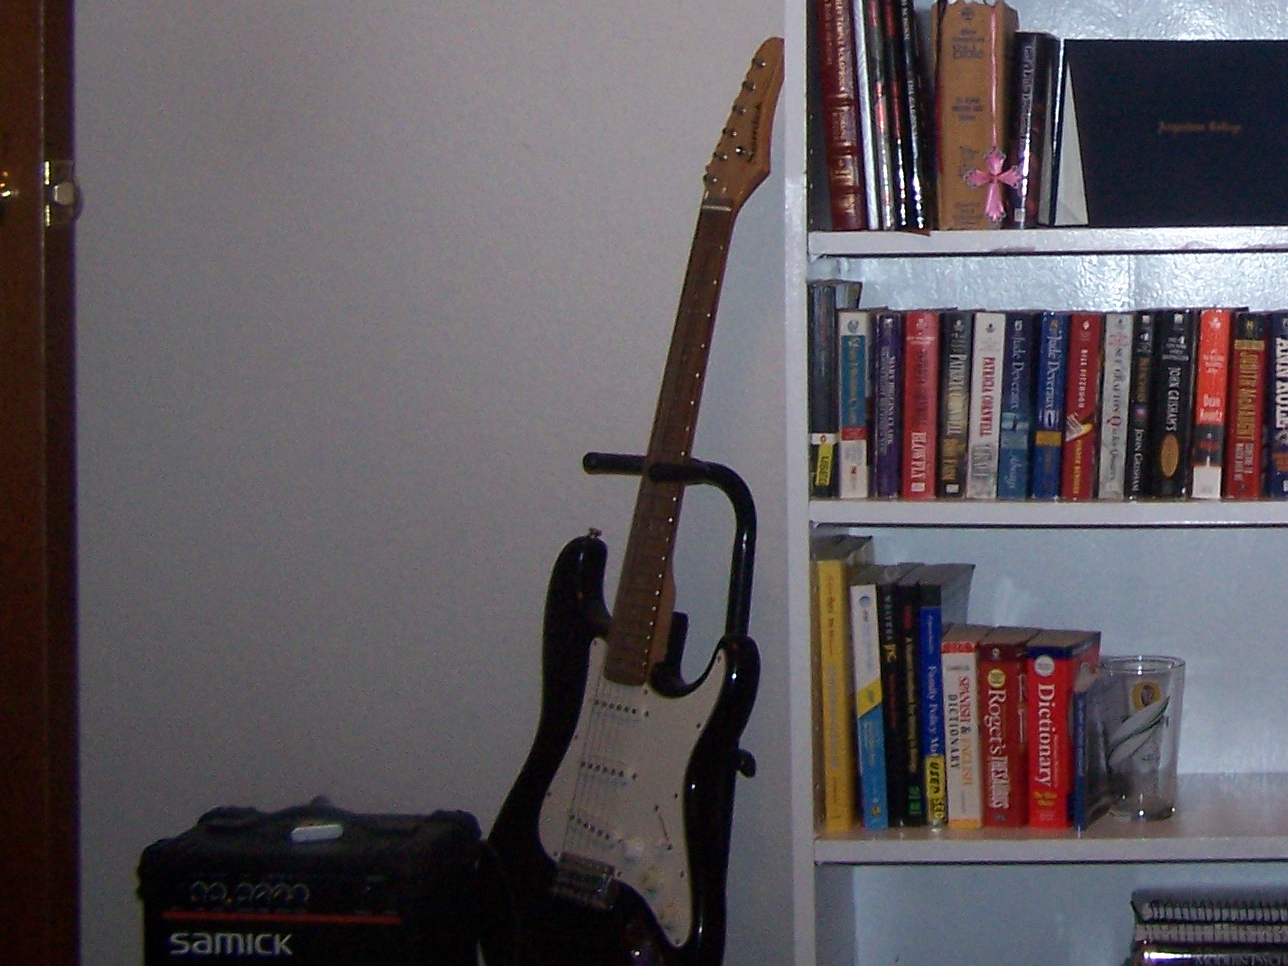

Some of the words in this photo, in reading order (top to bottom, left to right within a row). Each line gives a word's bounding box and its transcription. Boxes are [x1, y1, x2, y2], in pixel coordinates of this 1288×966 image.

[1047, 333, 1062, 359] Jude
[982, 356, 996, 393] PATRICIA
[1045, 361, 1060, 409] Deveraux
[1168, 366, 1182, 387] JOHN
[980, 395, 994, 437] CORNWELL
[927, 666, 936, 700] Family
[958, 676, 972, 722] SPANISH
[929, 704, 939, 733] Policy
[948, 694, 960, 770] DICTIONARY
[984, 689, 1007, 756] Roget's
[1034, 683, 1056, 787] Dictionary
[930, 762, 940, 794] USED
